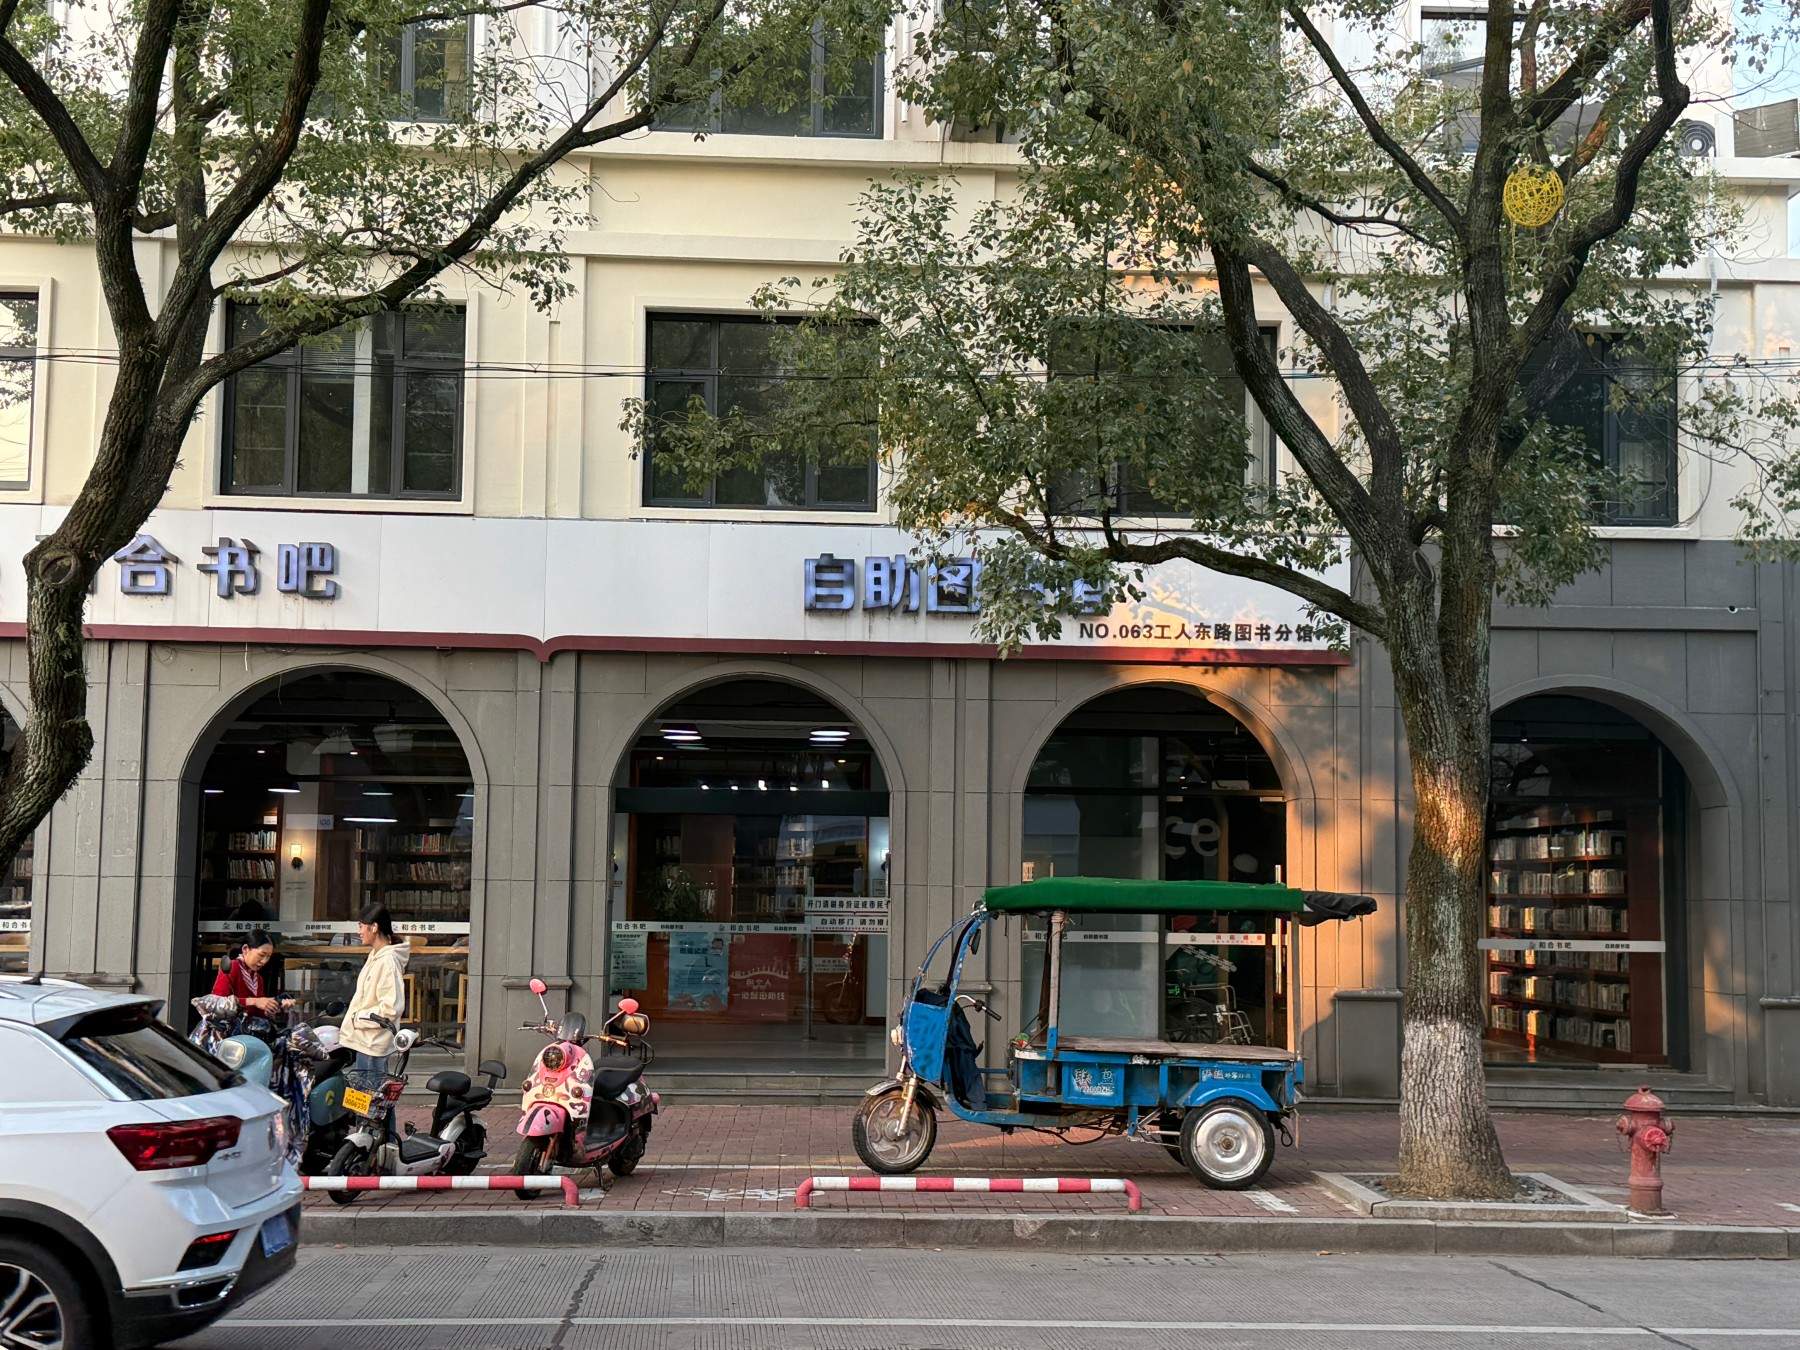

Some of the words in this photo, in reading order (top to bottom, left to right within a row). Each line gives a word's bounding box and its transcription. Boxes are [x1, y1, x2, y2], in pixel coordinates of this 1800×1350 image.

[86, 534, 337, 599] 合书吧
[2, 921, 32, 929] 和合书
